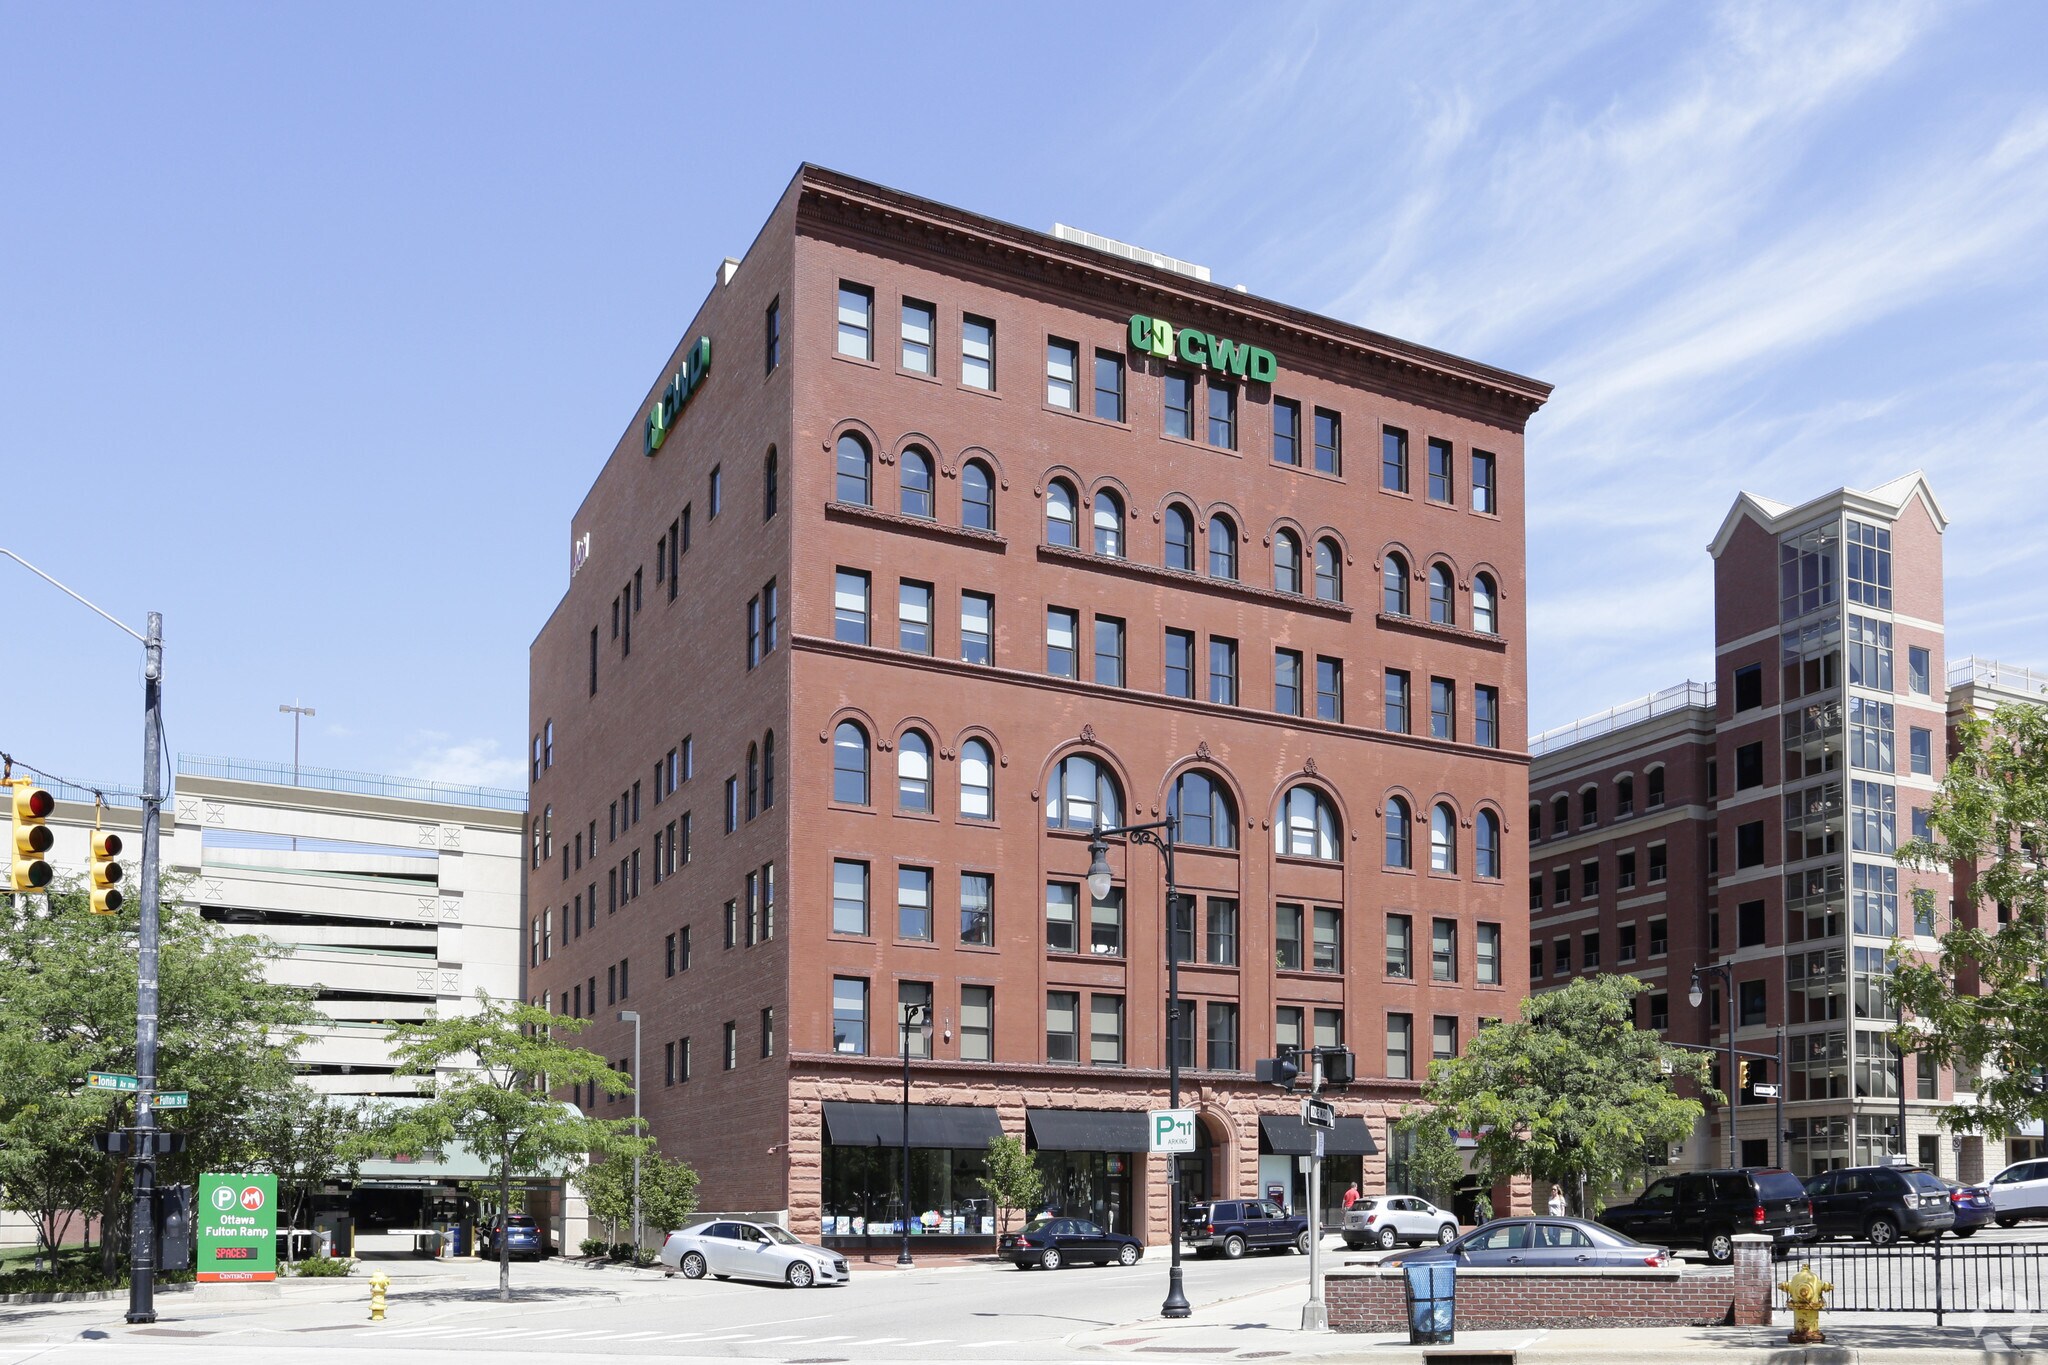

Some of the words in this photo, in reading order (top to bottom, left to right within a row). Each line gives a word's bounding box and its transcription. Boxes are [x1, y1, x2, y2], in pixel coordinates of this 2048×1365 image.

[1176, 328, 1278, 383] CWD
[98, 1075, 117, 1087] Ionia
[159, 1095, 176, 1105] Fulton
[1156, 1116, 1175, 1145] P
[218, 1189, 232, 1207] P
[220, 1215, 255, 1225] Ottawa
[205, 1226, 237, 1236] Fulton
[239, 1226, 269, 1239] Ramp
[215, 1248, 247, 1258] SPACES
